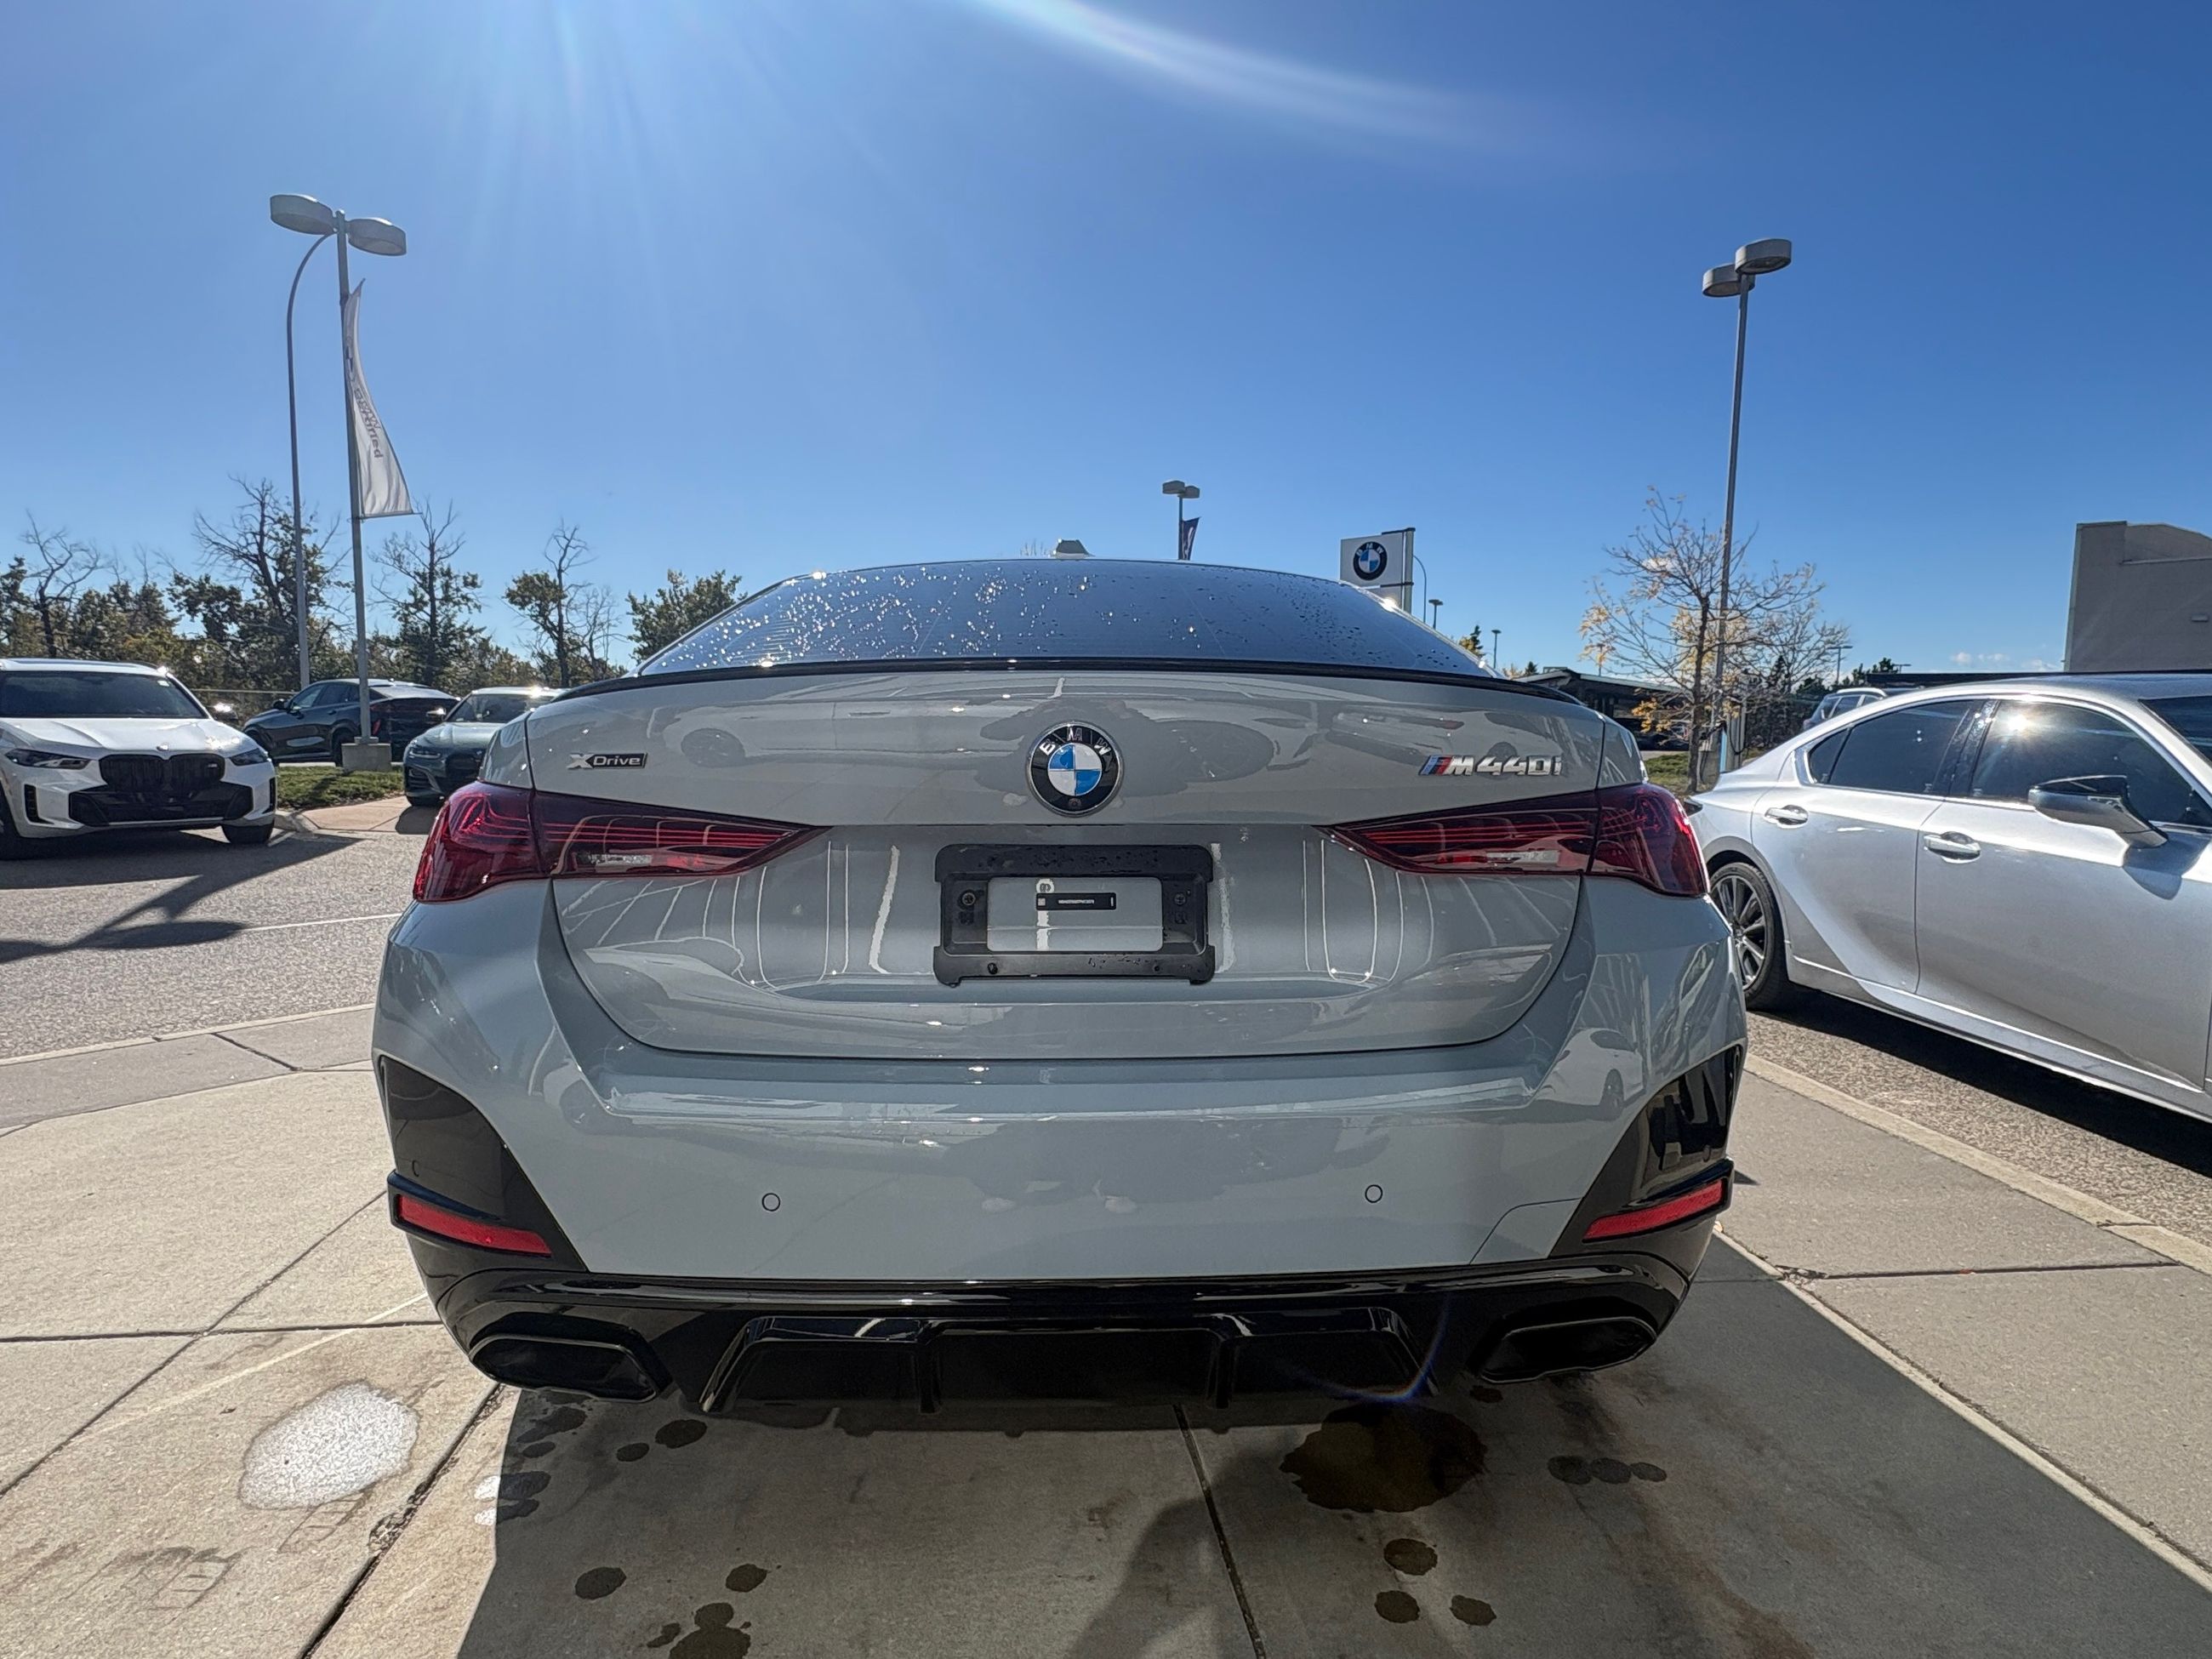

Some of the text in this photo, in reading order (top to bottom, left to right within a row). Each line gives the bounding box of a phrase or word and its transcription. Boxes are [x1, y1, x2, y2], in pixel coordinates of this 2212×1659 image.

[1356, 542, 1385, 557] BMW
[1039, 727, 1112, 756] BMW
[1442, 755, 1562, 776] M440i
